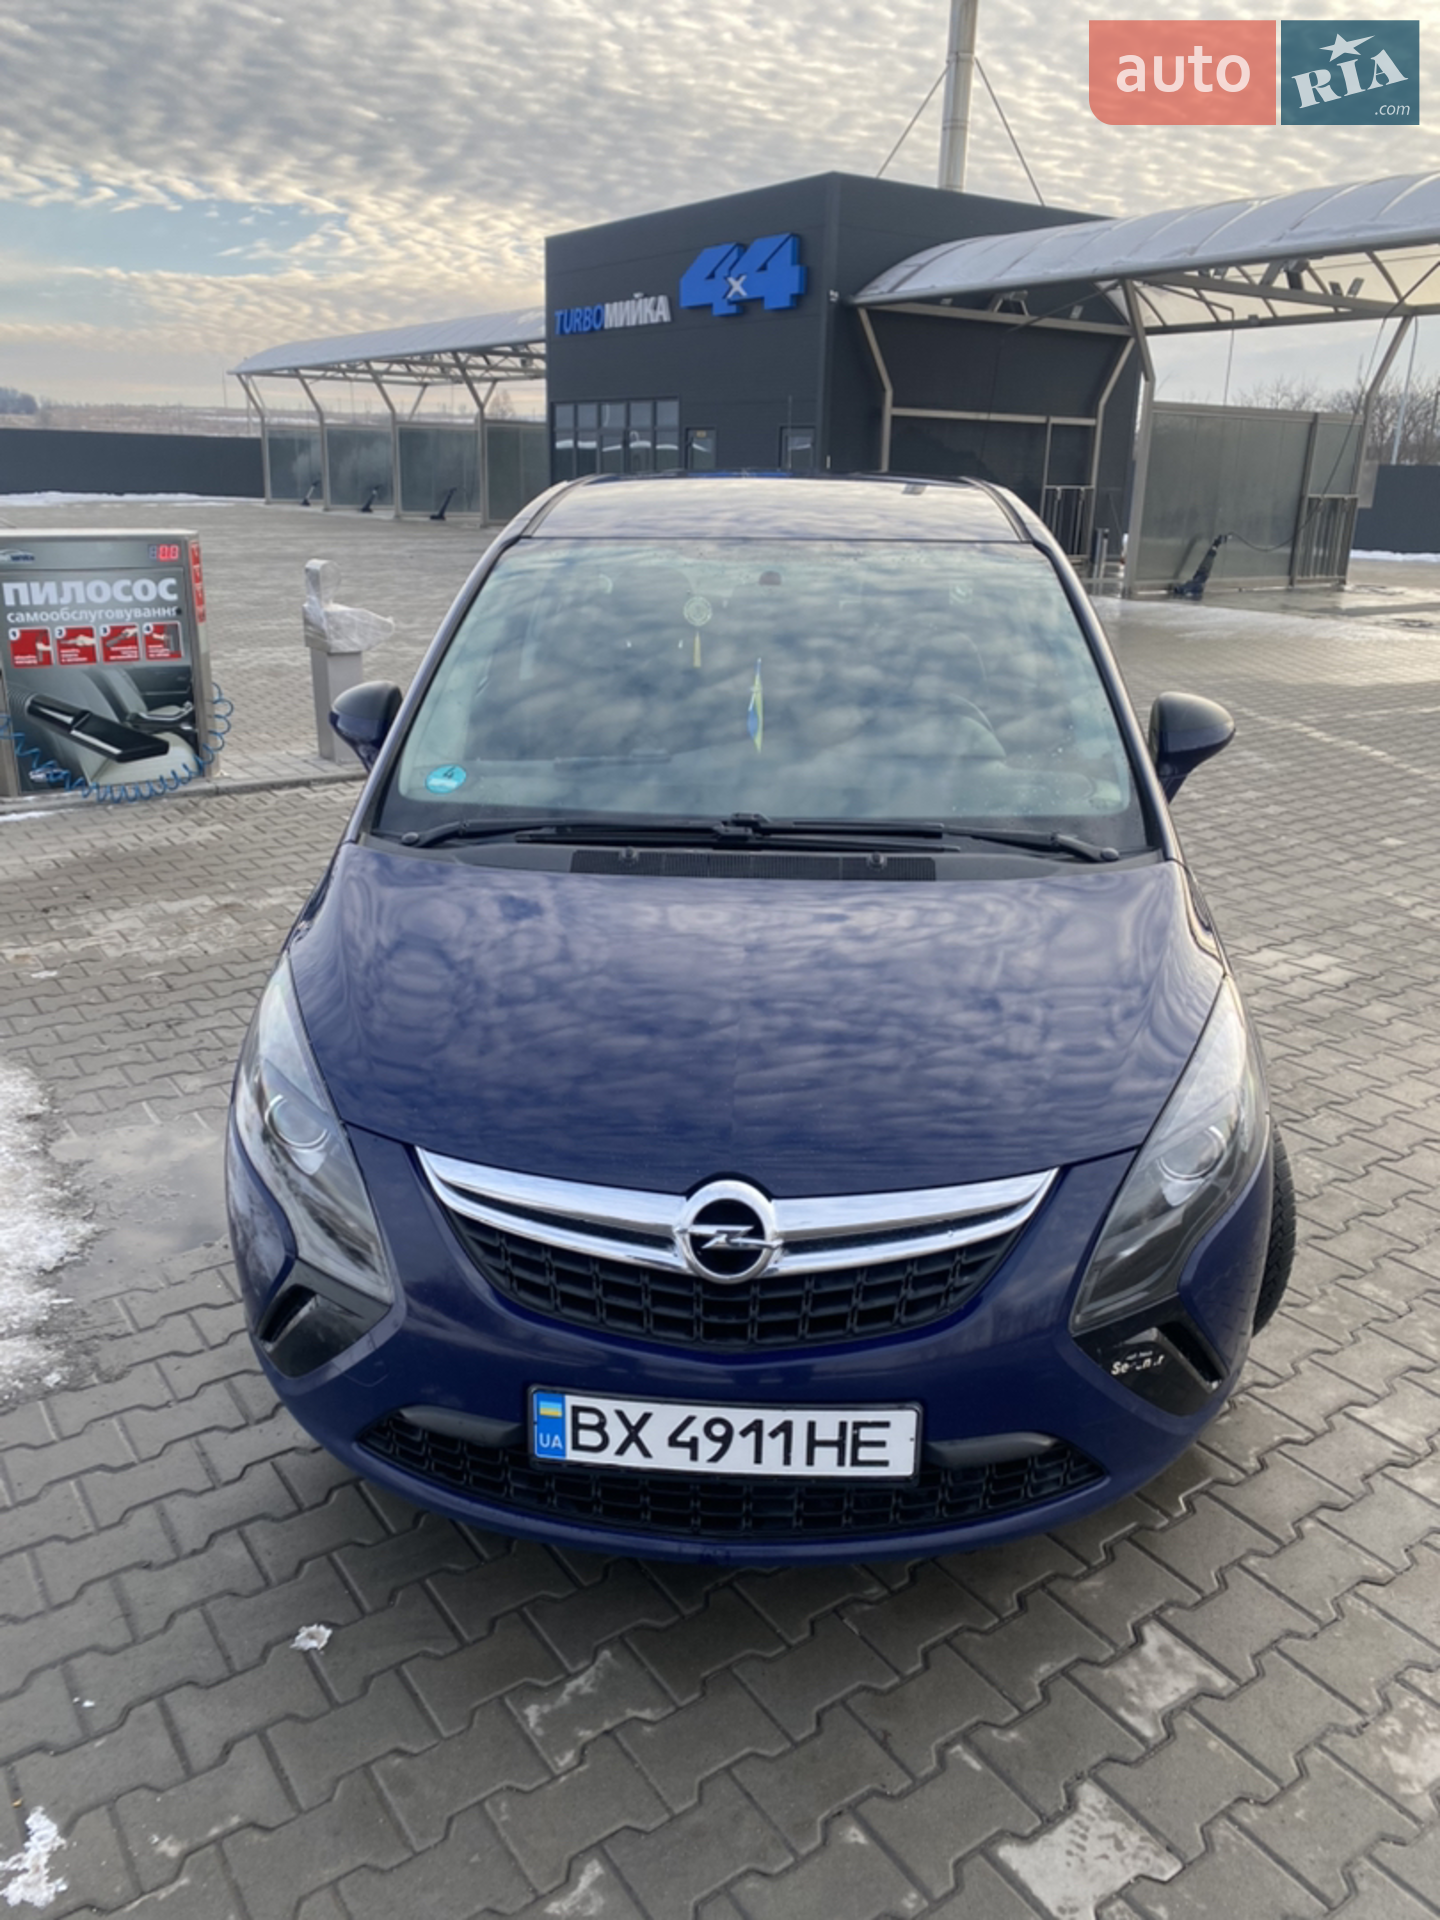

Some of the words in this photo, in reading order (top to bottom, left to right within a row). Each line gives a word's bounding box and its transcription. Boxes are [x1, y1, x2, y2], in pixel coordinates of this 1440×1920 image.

[538, 1432, 563, 1450] UA
[570, 1404, 653, 1459] BX
[667, 1415, 793, 1467] 4911
[805, 1420, 891, 1467] HE
